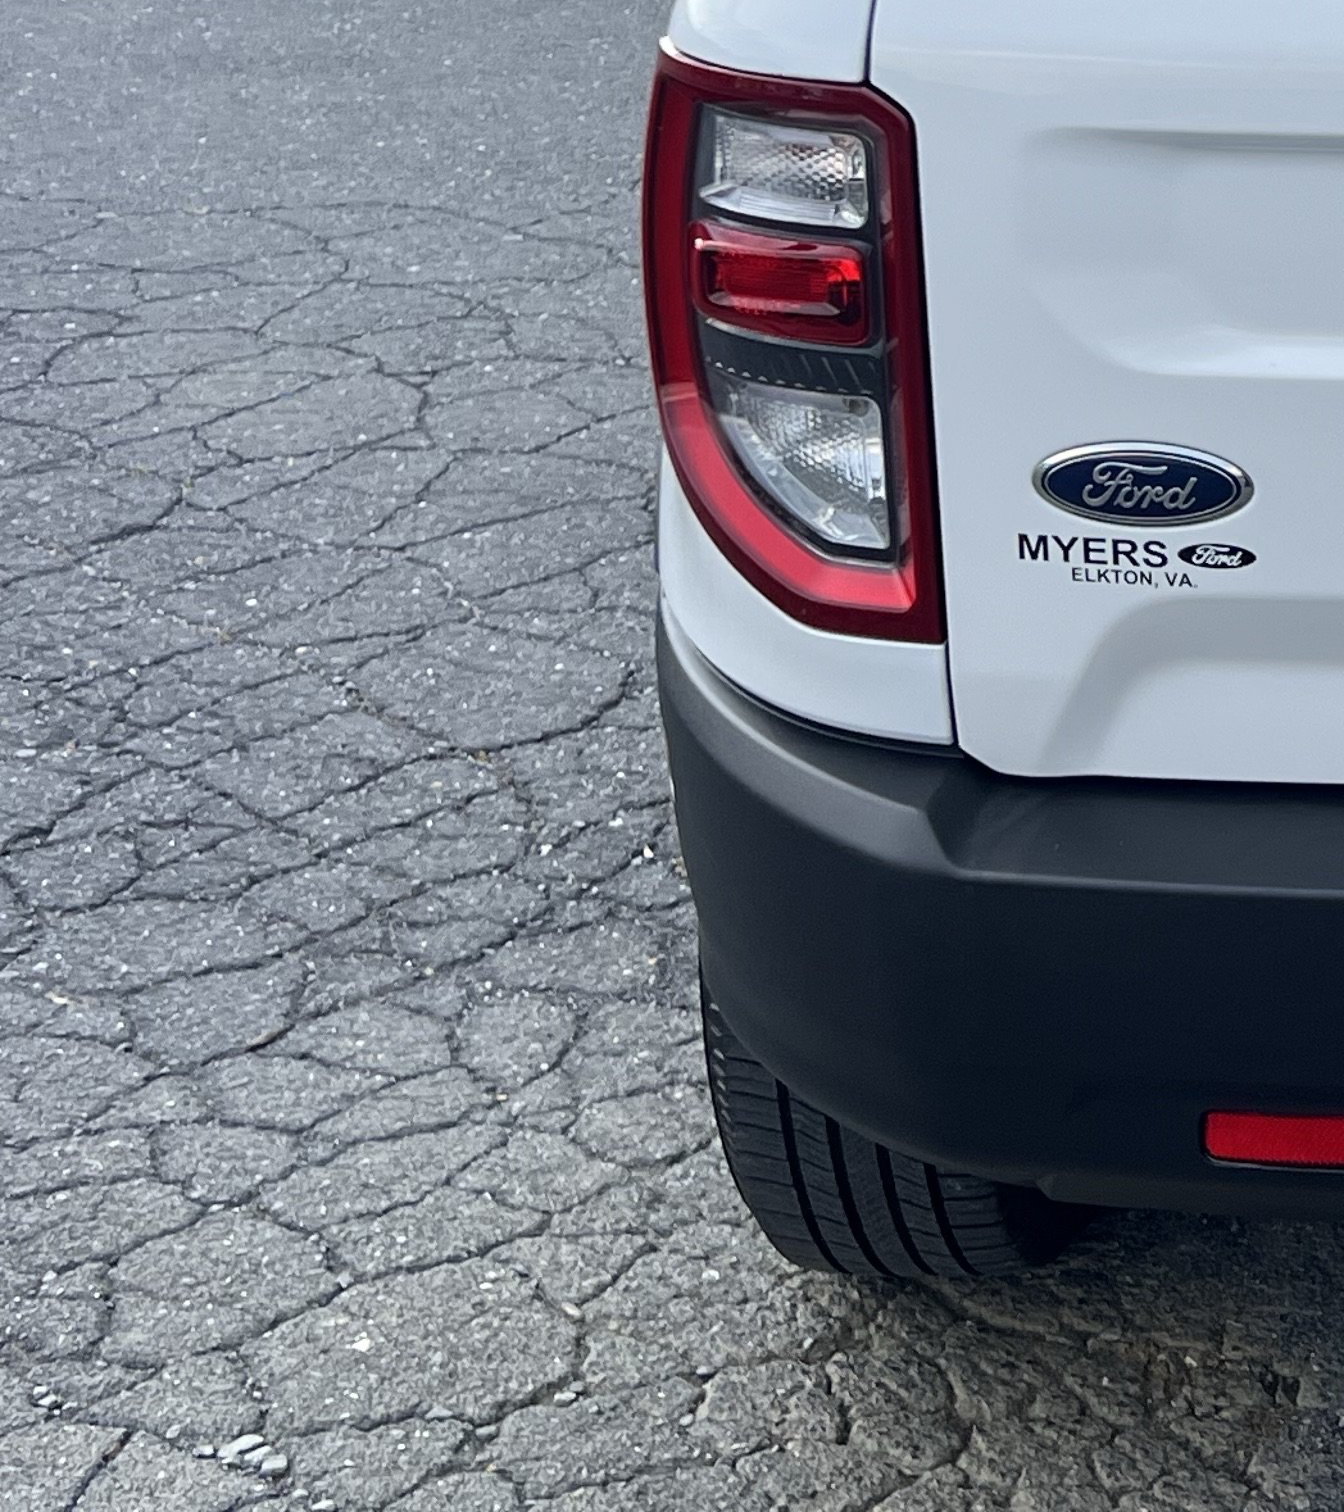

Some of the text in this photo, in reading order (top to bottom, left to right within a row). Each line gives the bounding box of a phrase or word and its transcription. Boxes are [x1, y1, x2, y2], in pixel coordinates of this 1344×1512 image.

[1082, 461, 1199, 511] Ford
[1017, 533, 1243, 568] MYERS Ford
[1072, 567, 1160, 590] ELKTON,
